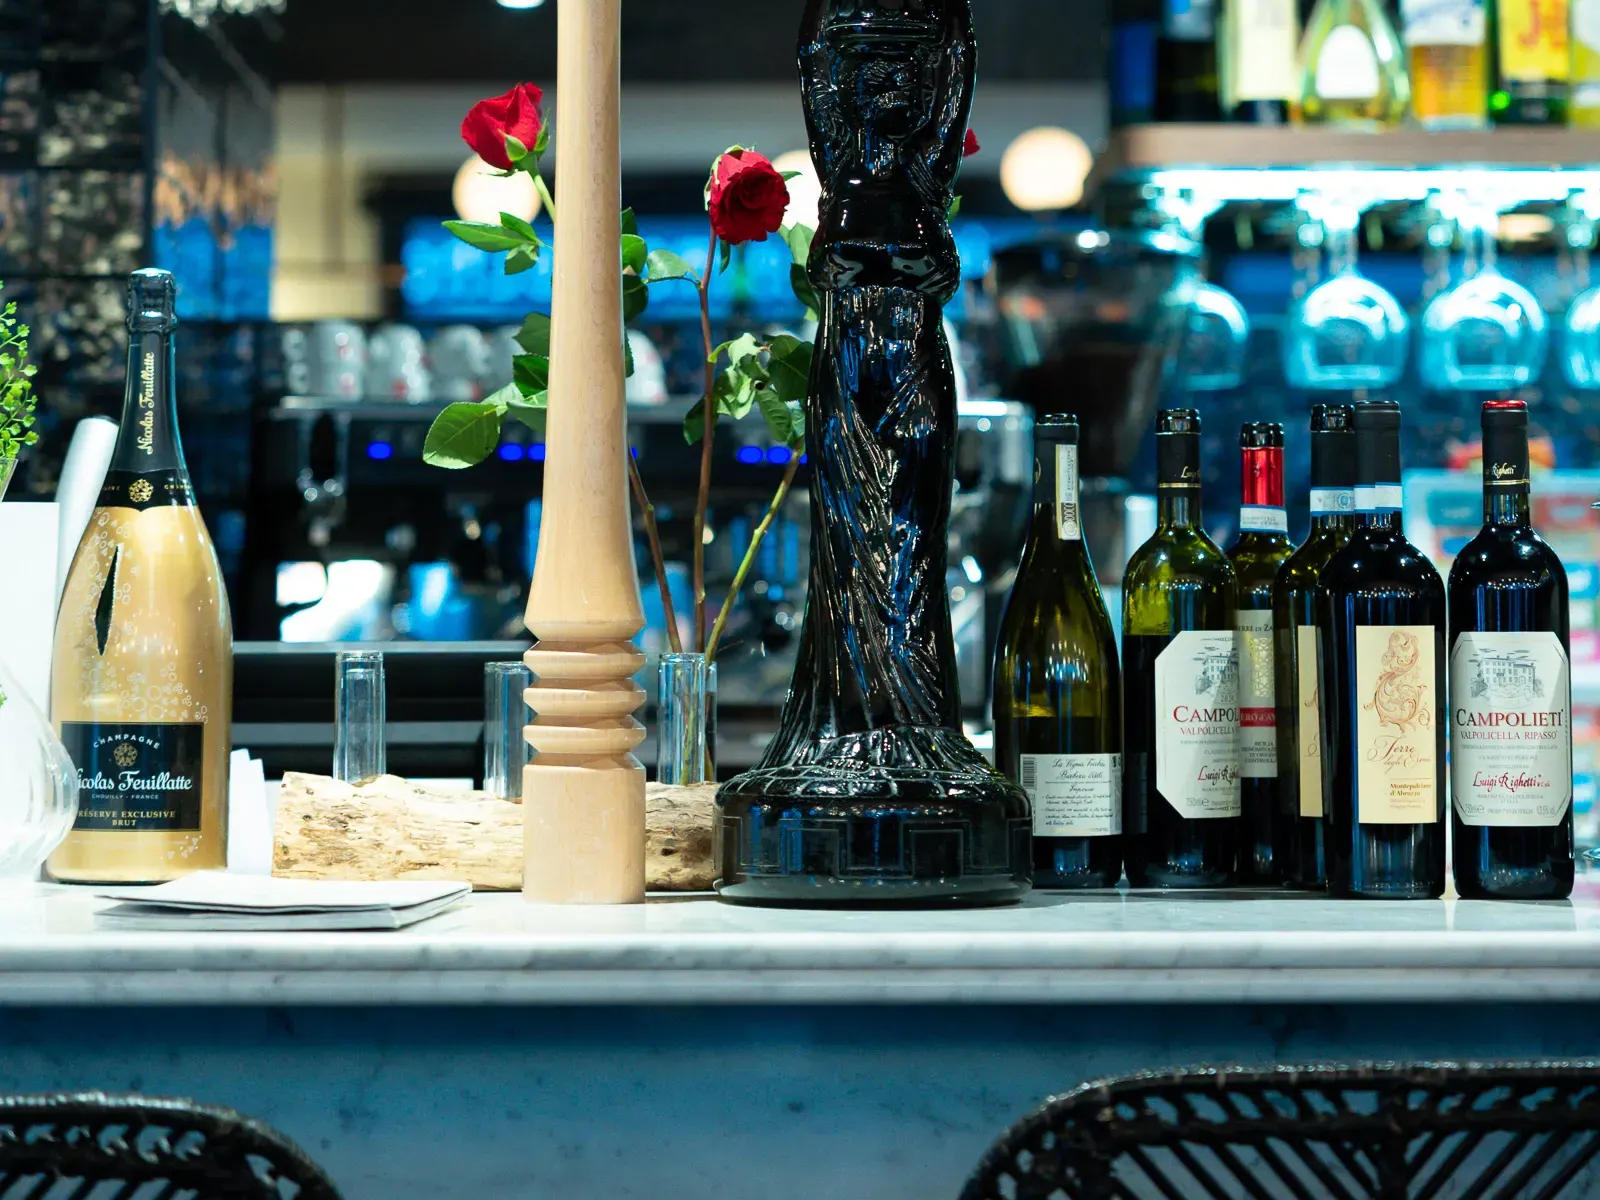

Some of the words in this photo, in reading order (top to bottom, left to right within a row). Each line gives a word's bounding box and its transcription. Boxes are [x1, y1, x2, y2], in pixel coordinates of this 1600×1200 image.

[139, 352, 155, 409] Feuillatte
[137, 409, 154, 455] Nicolas
[1456, 708, 1563, 727] CAMPOLIETI
[93, 734, 160, 750] CHAMPAGNE
[1460, 731, 1521, 740] VALPOLICELLA
[1524, 731, 1557, 740] RIPASSO
[1367, 734, 1415, 762] Terre
[118, 770, 193, 792] Feuillatte
[1197, 765, 1221, 786] Luigi
[1472, 771, 1497, 792] Luigi
[1498, 771, 1537, 793] Righetti
[78, 807, 118, 818] RÉSERVE
[121, 809, 176, 818] EXCLUSIVE
[112, 819, 137, 827] BRUT
